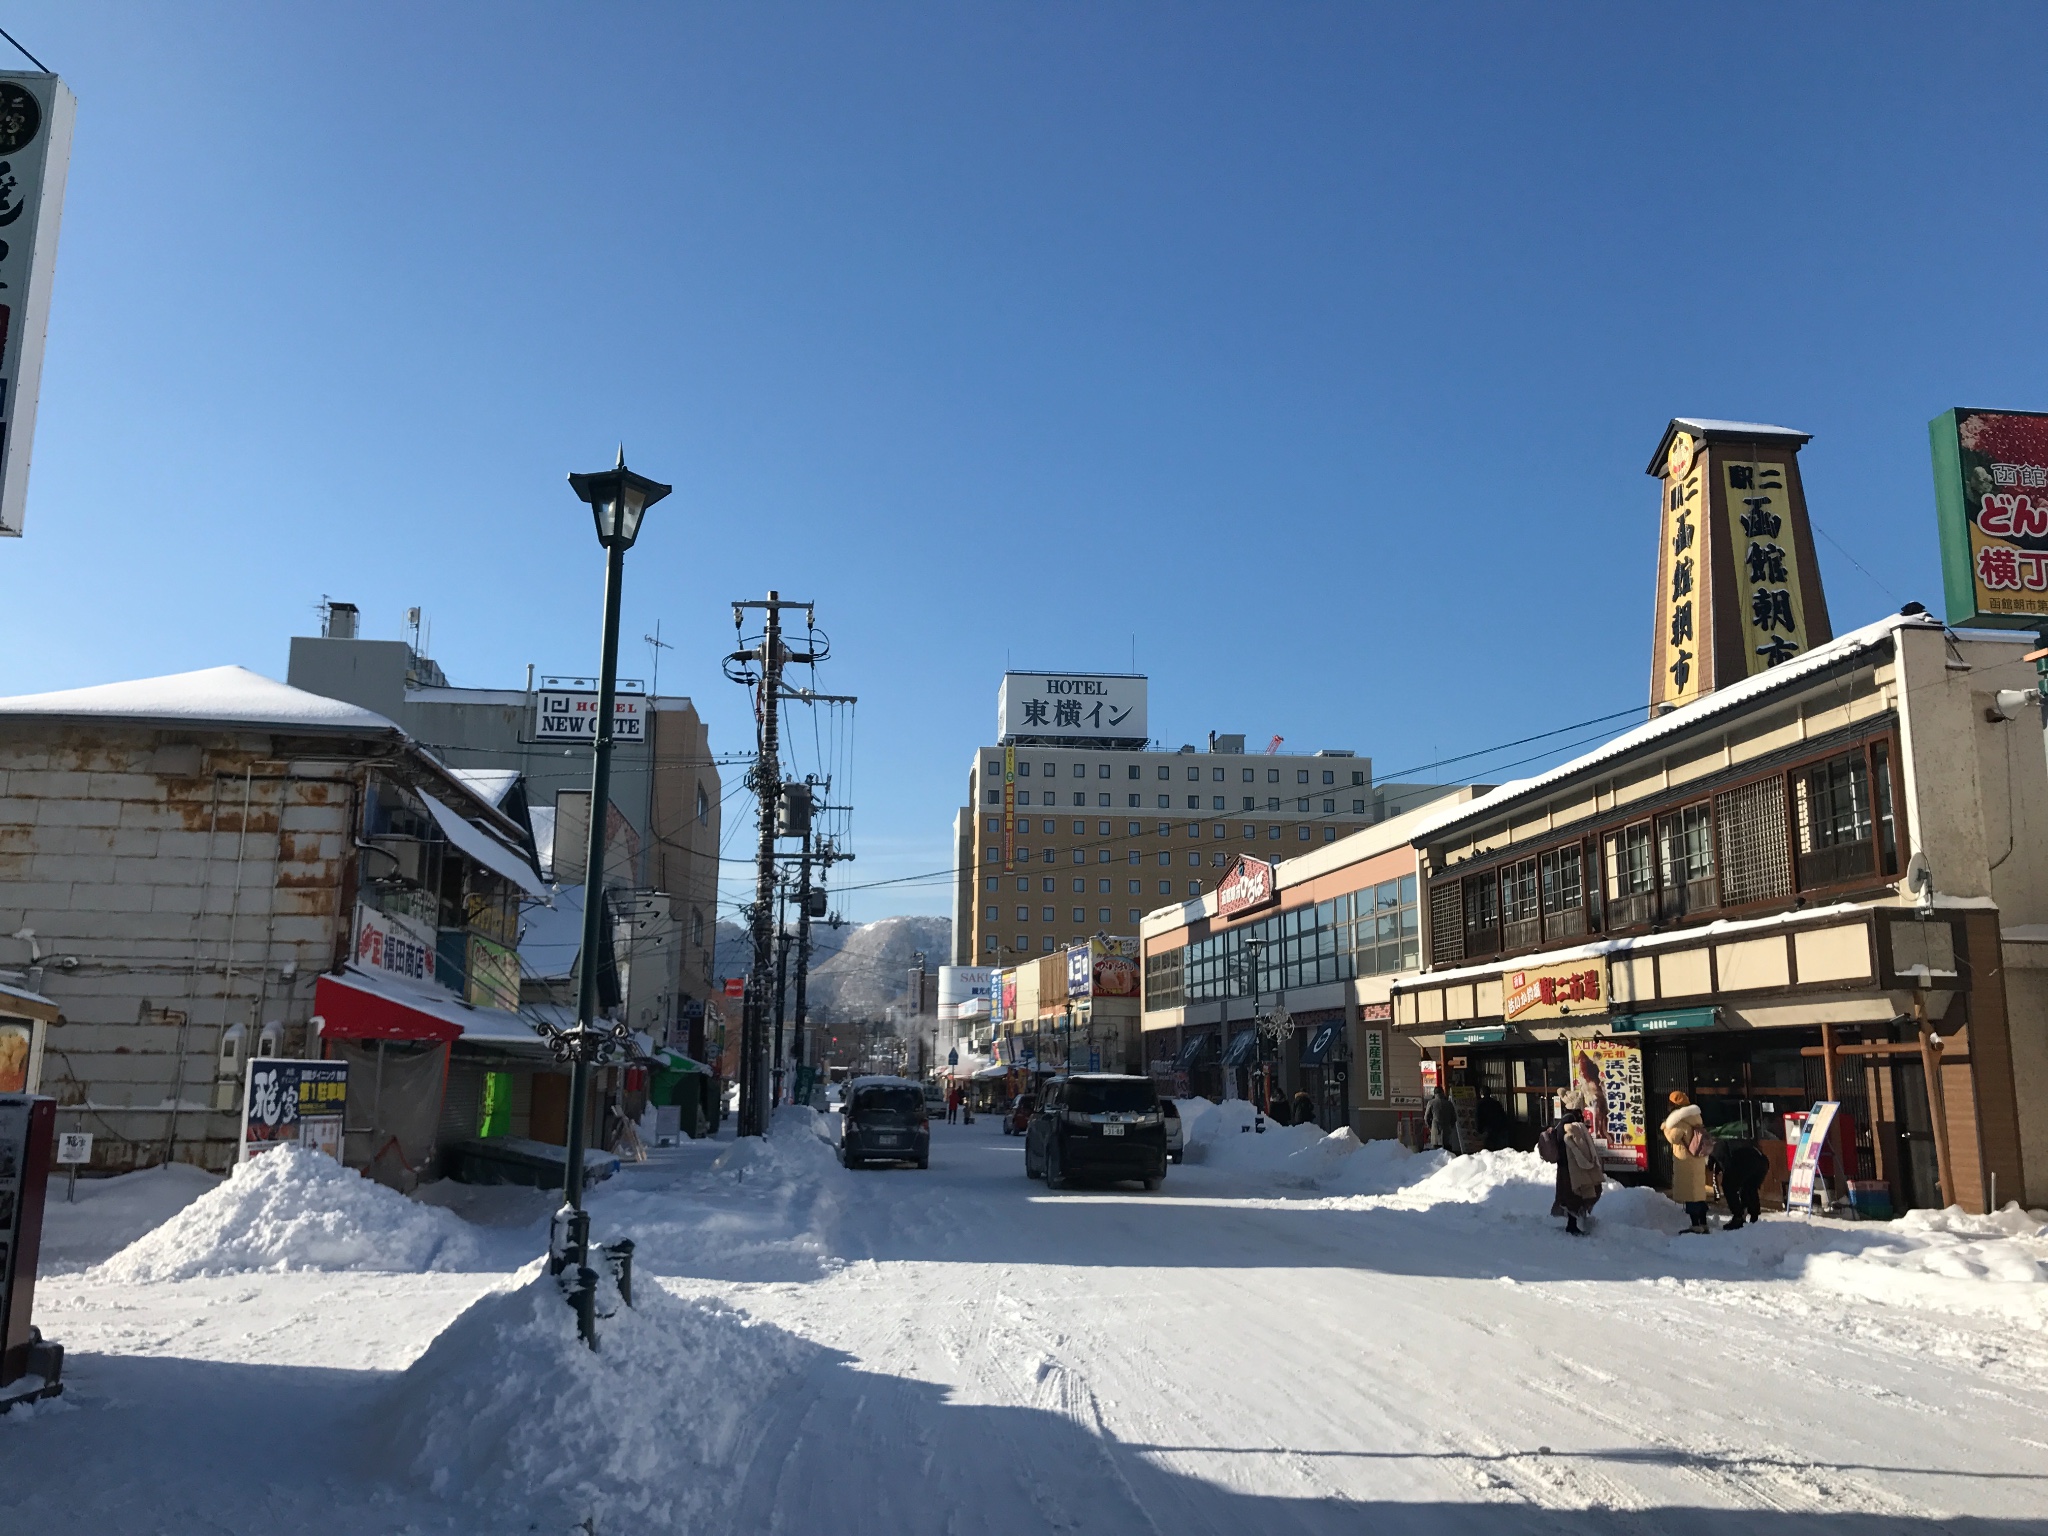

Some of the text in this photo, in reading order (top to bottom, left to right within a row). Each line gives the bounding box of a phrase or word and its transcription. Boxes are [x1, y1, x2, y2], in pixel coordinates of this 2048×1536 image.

[1728, 465, 1782, 490] 駅二
[1991, 463, 2047, 488] 函館
[1979, 494, 2048, 536] どん
[1740, 496, 1799, 668] 函館朝市
[1978, 547, 2048, 589] 横丁
[1669, 508, 1695, 695] 函館朝市
[1046, 680, 1108, 696] HOTEL
[542, 715, 585, 734] NEW
[576, 701, 637, 714] HOEL
[1021, 698, 1133, 728] 東横イン
[384, 933, 424, 980] 福田商店
[1541, 969, 1600, 1006] 駅二市場
[1368, 1033, 1383, 1097] 生産者直売
[1602, 1050, 1625, 1059] 元祖
[1628, 1054, 1643, 1125] えきに市場名物
